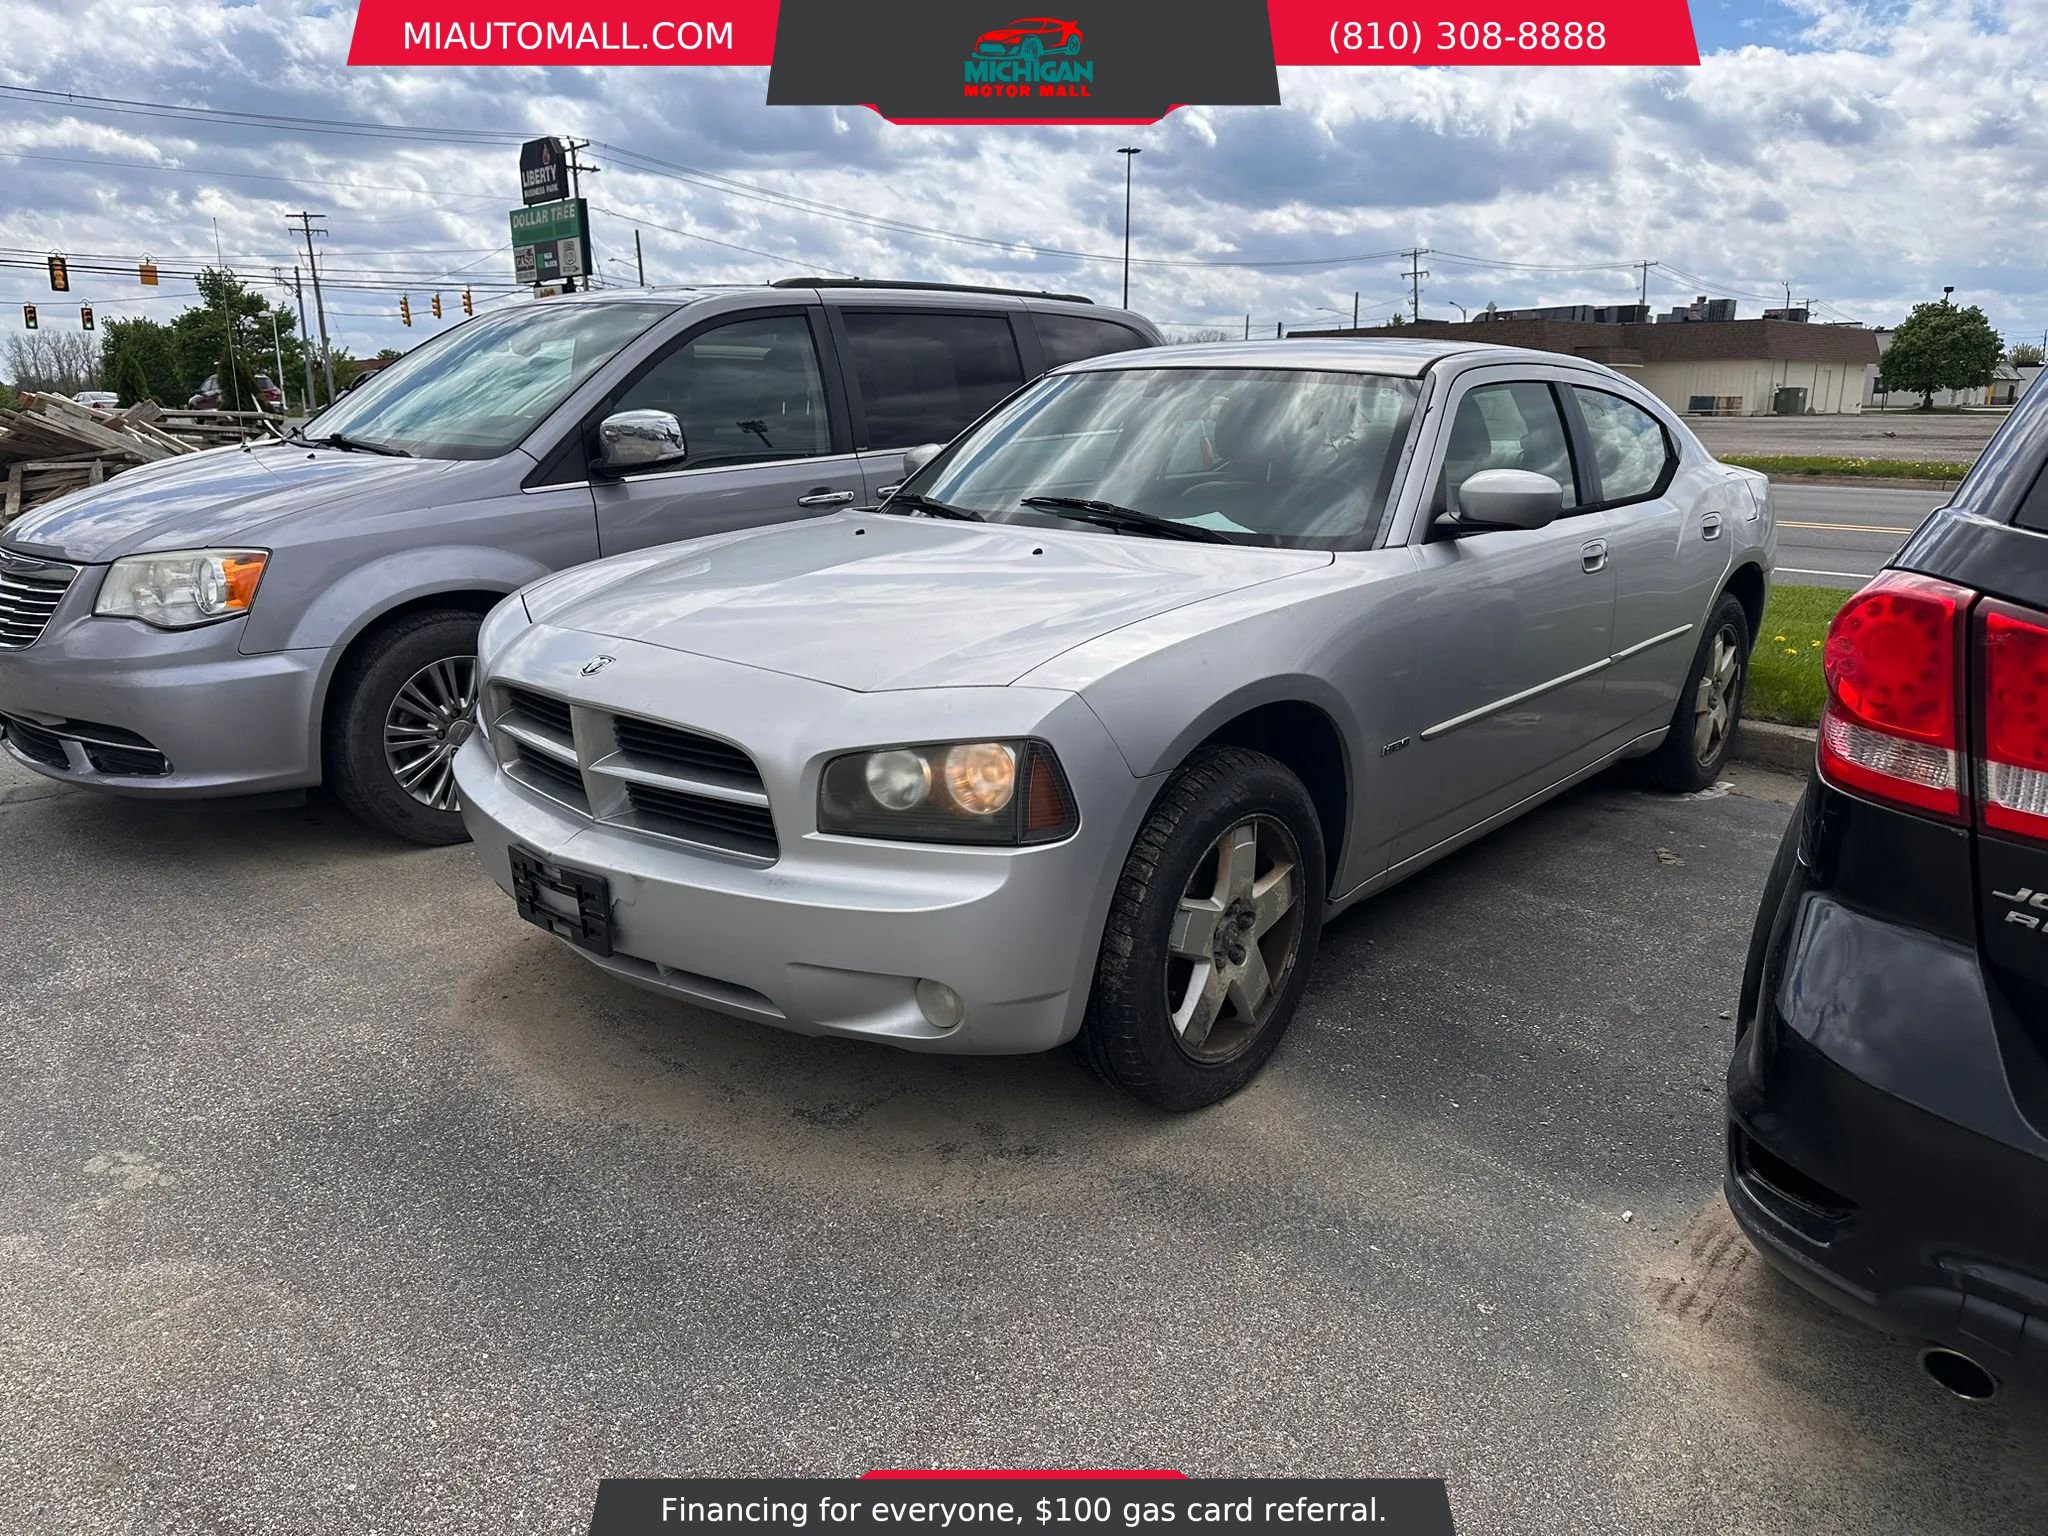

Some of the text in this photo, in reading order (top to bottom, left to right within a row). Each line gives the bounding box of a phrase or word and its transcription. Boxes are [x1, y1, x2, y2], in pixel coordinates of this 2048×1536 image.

[522, 165, 557, 187] LIBERTY
[513, 204, 576, 228] DOLLAR TREE
